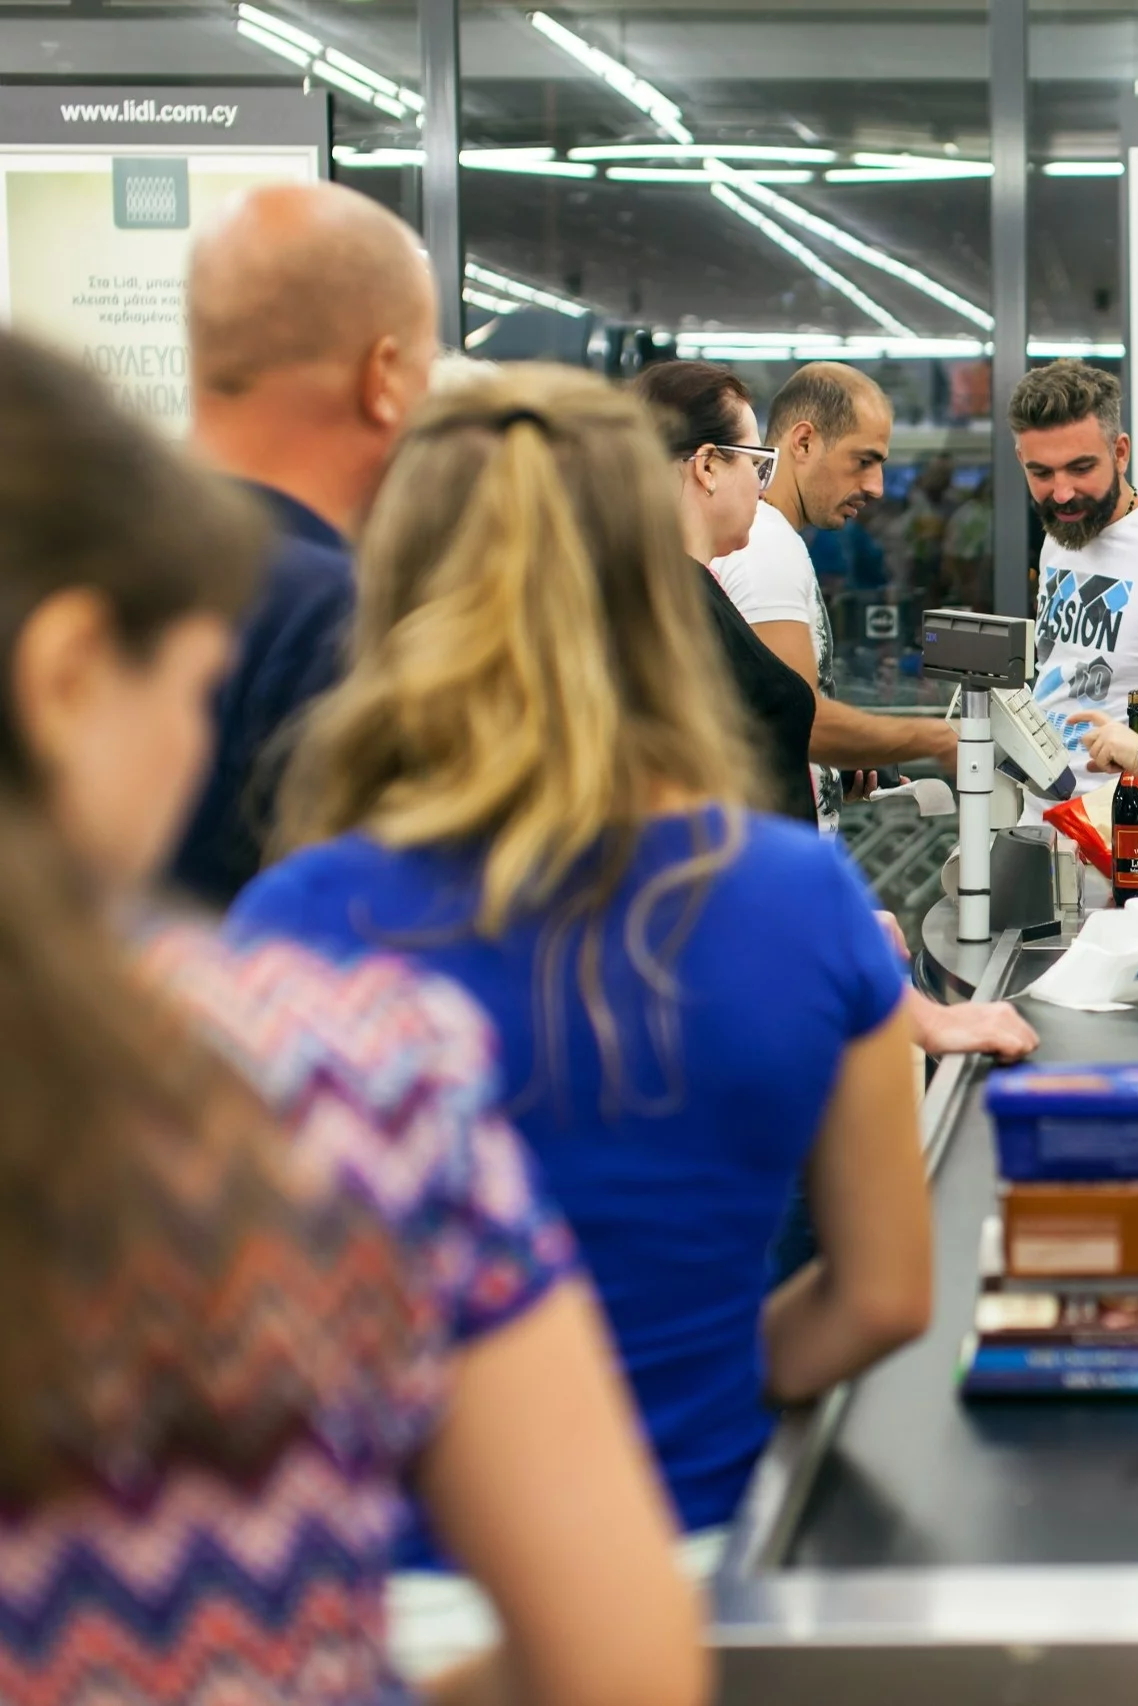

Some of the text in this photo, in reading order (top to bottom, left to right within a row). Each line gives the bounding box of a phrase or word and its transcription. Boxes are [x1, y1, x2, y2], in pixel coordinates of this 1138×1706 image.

[60, 100, 238, 128] www.lidl.com.cy
[88, 275, 110, 289] Στα
[113, 276, 142, 290] Lidl,
[1037, 595, 1123, 653] PASSION
